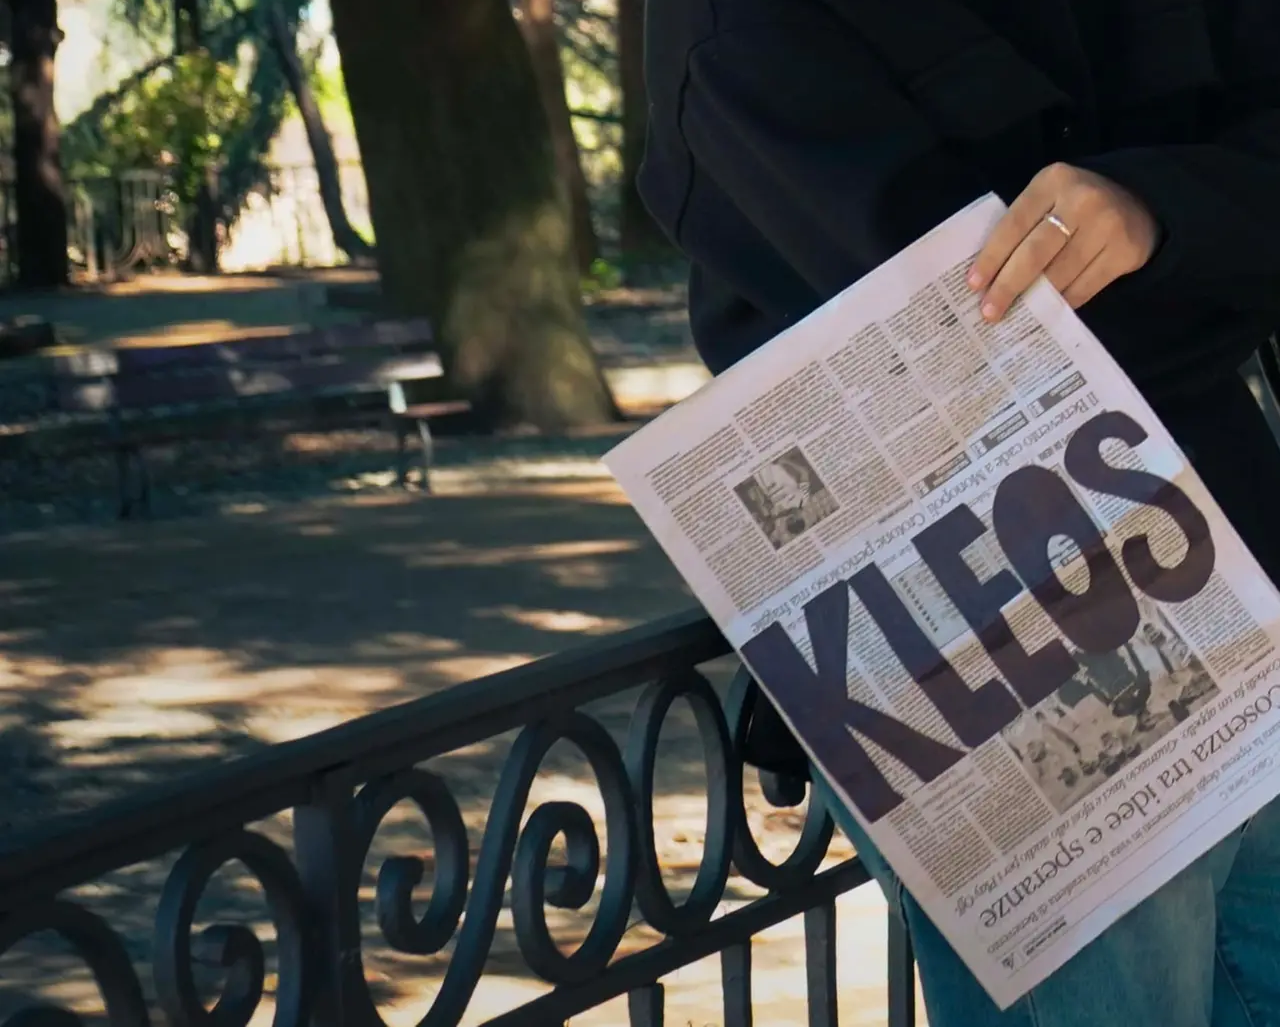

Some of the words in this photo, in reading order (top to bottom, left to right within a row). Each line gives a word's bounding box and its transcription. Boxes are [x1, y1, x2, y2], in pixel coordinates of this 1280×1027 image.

[1085, 390, 1100, 406] Il
[1020, 397, 1090, 451] Benevento
[983, 461, 995, 474] a
[991, 441, 1027, 472] cade
[922, 465, 989, 518] Monopoli
[873, 509, 928, 552] Crotone
[807, 540, 876, 595] pericoloso
[787, 586, 812, 608] ma
[740, 410, 1216, 824] KLEOS
[746, 597, 794, 637] fragile
[1215, 694, 1234, 712] un
[1228, 681, 1248, 701] fa
[1155, 755, 1195, 792] tra
[1101, 782, 1164, 838] idee
[1081, 822, 1107, 848] e
[971, 830, 1089, 930] speranze
[999, 855, 1023, 877] per
[970, 873, 999, 900] Play
[983, 909, 1039, 956] Benevento
